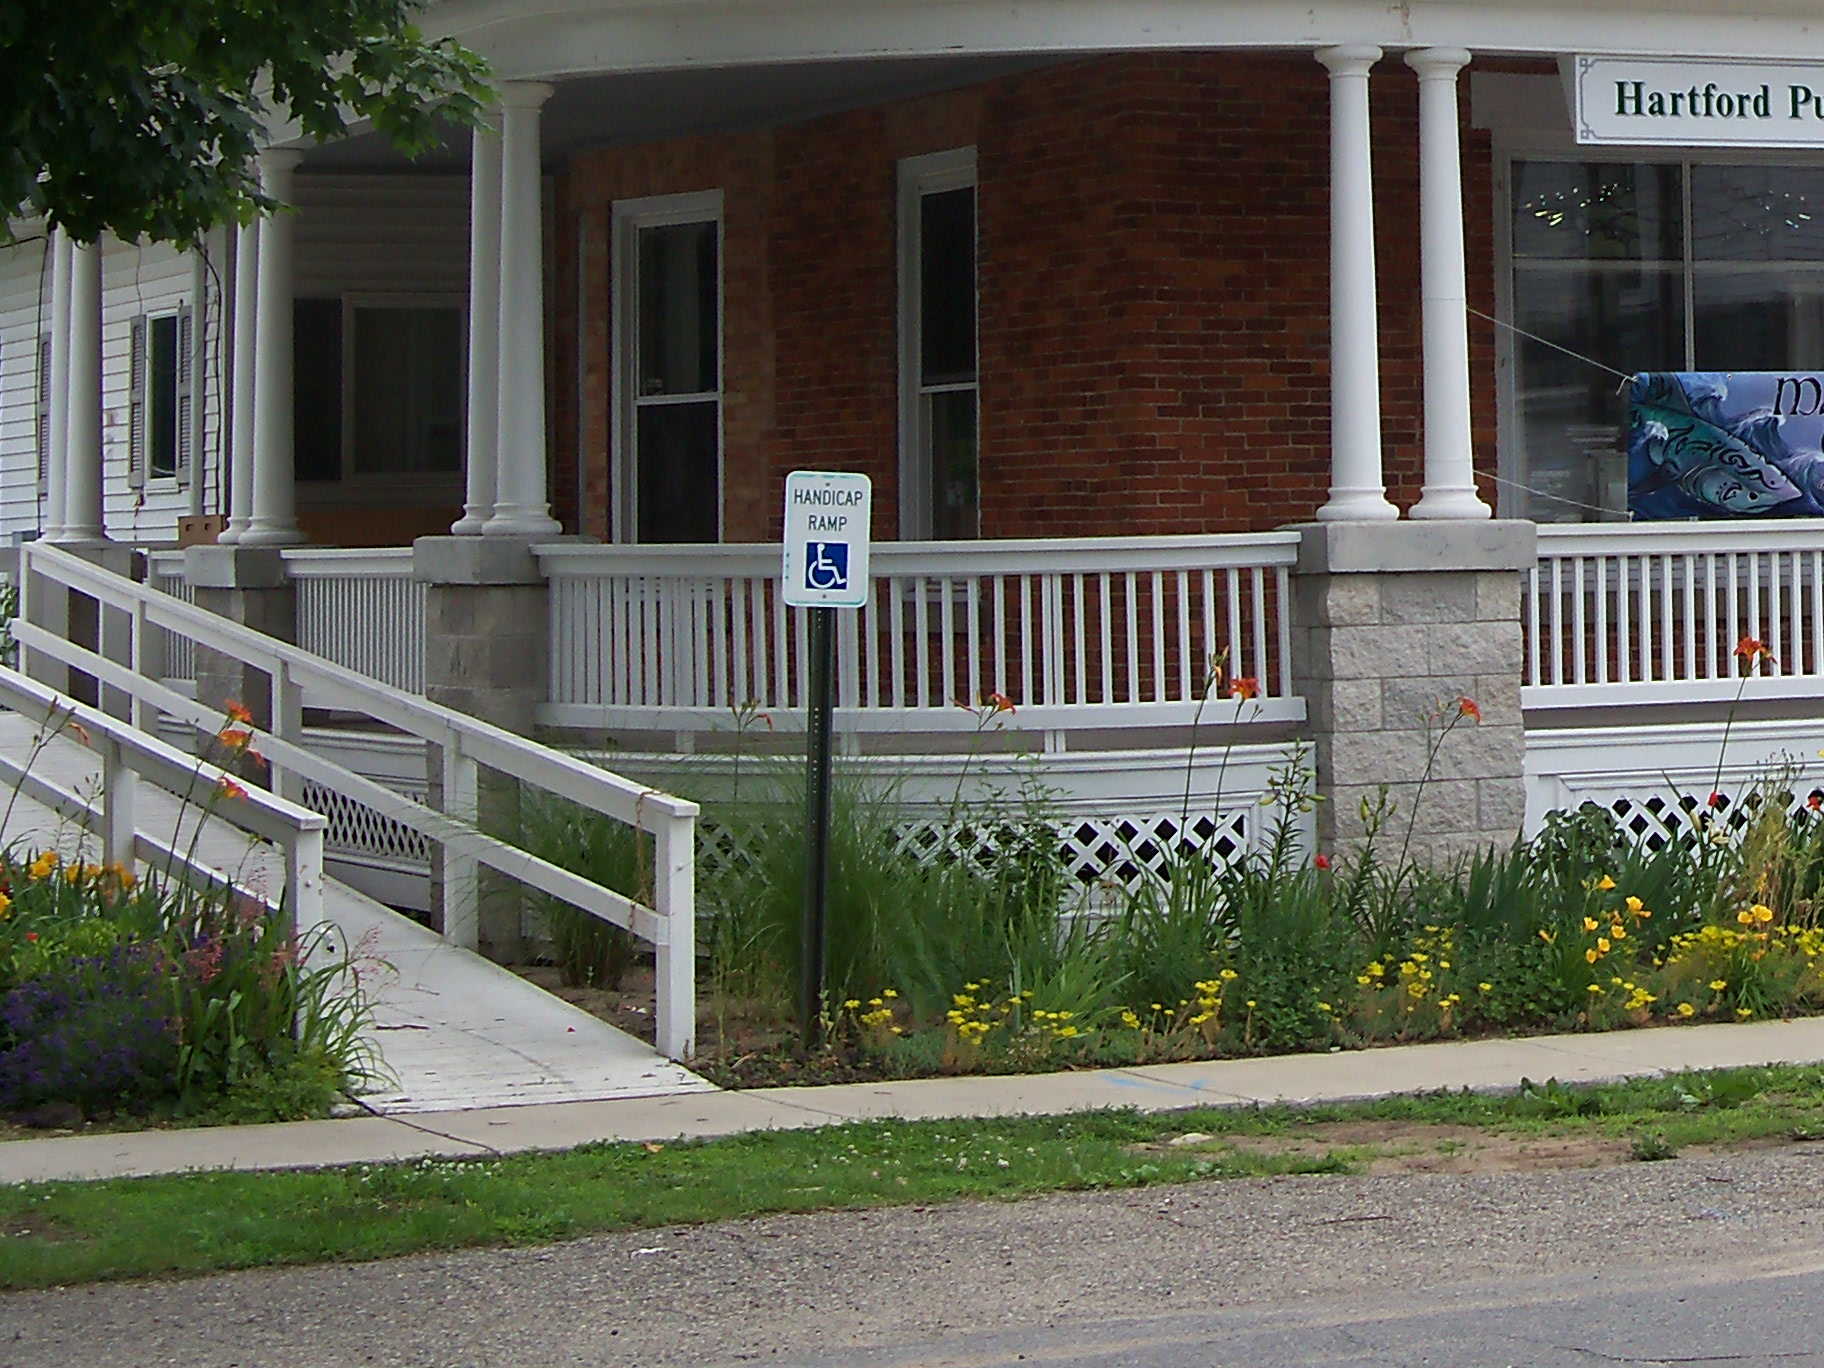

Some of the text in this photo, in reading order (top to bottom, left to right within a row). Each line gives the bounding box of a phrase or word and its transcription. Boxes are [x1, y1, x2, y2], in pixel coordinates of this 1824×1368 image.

[1614, 80, 1771, 119] Hartford
[793, 488, 863, 507] HANDICAP
[807, 514, 848, 532] RAMP
